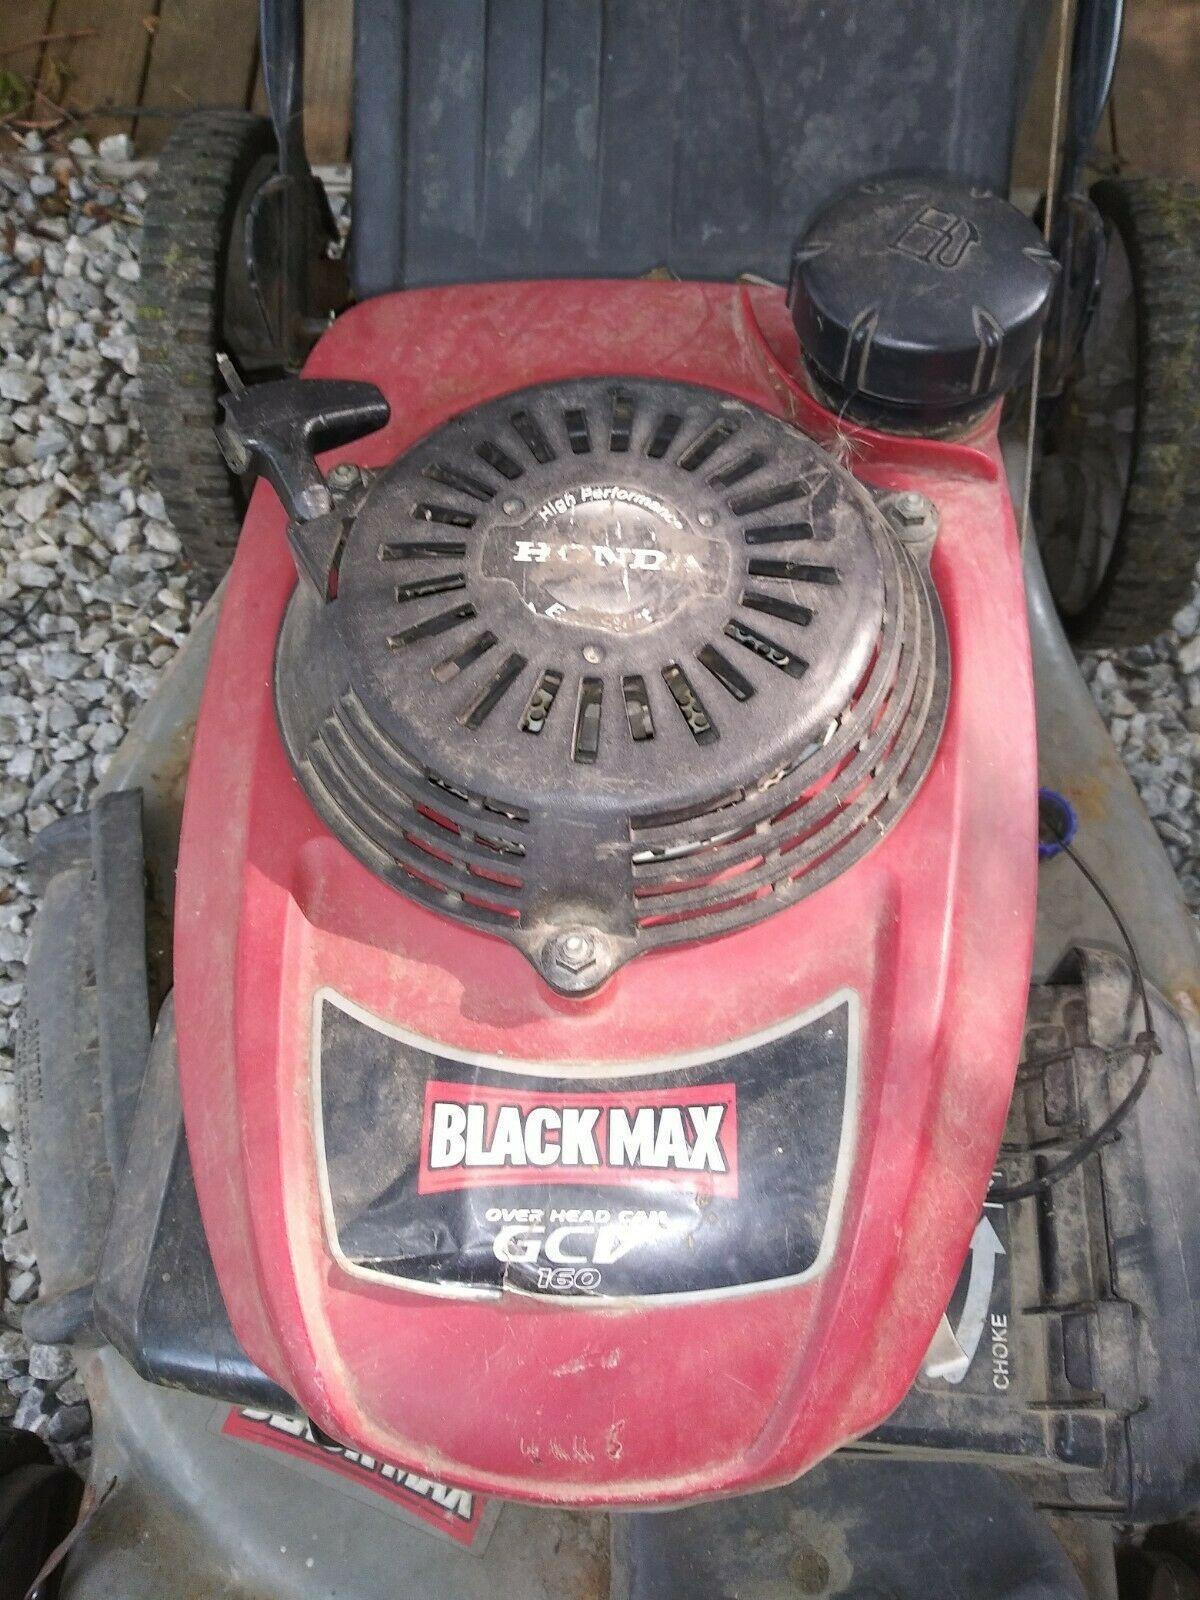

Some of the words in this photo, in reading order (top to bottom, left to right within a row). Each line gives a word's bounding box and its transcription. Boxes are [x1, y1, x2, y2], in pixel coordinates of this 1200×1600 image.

[430, 1102, 601, 1168] BLACK
[609, 1105, 728, 1172] MAX
[485, 1208, 544, 1223] OVER
[550, 1209, 611, 1224] HEAD
[537, 1267, 602, 1290] 160
[990, 1313, 1010, 1390] CHOKE
